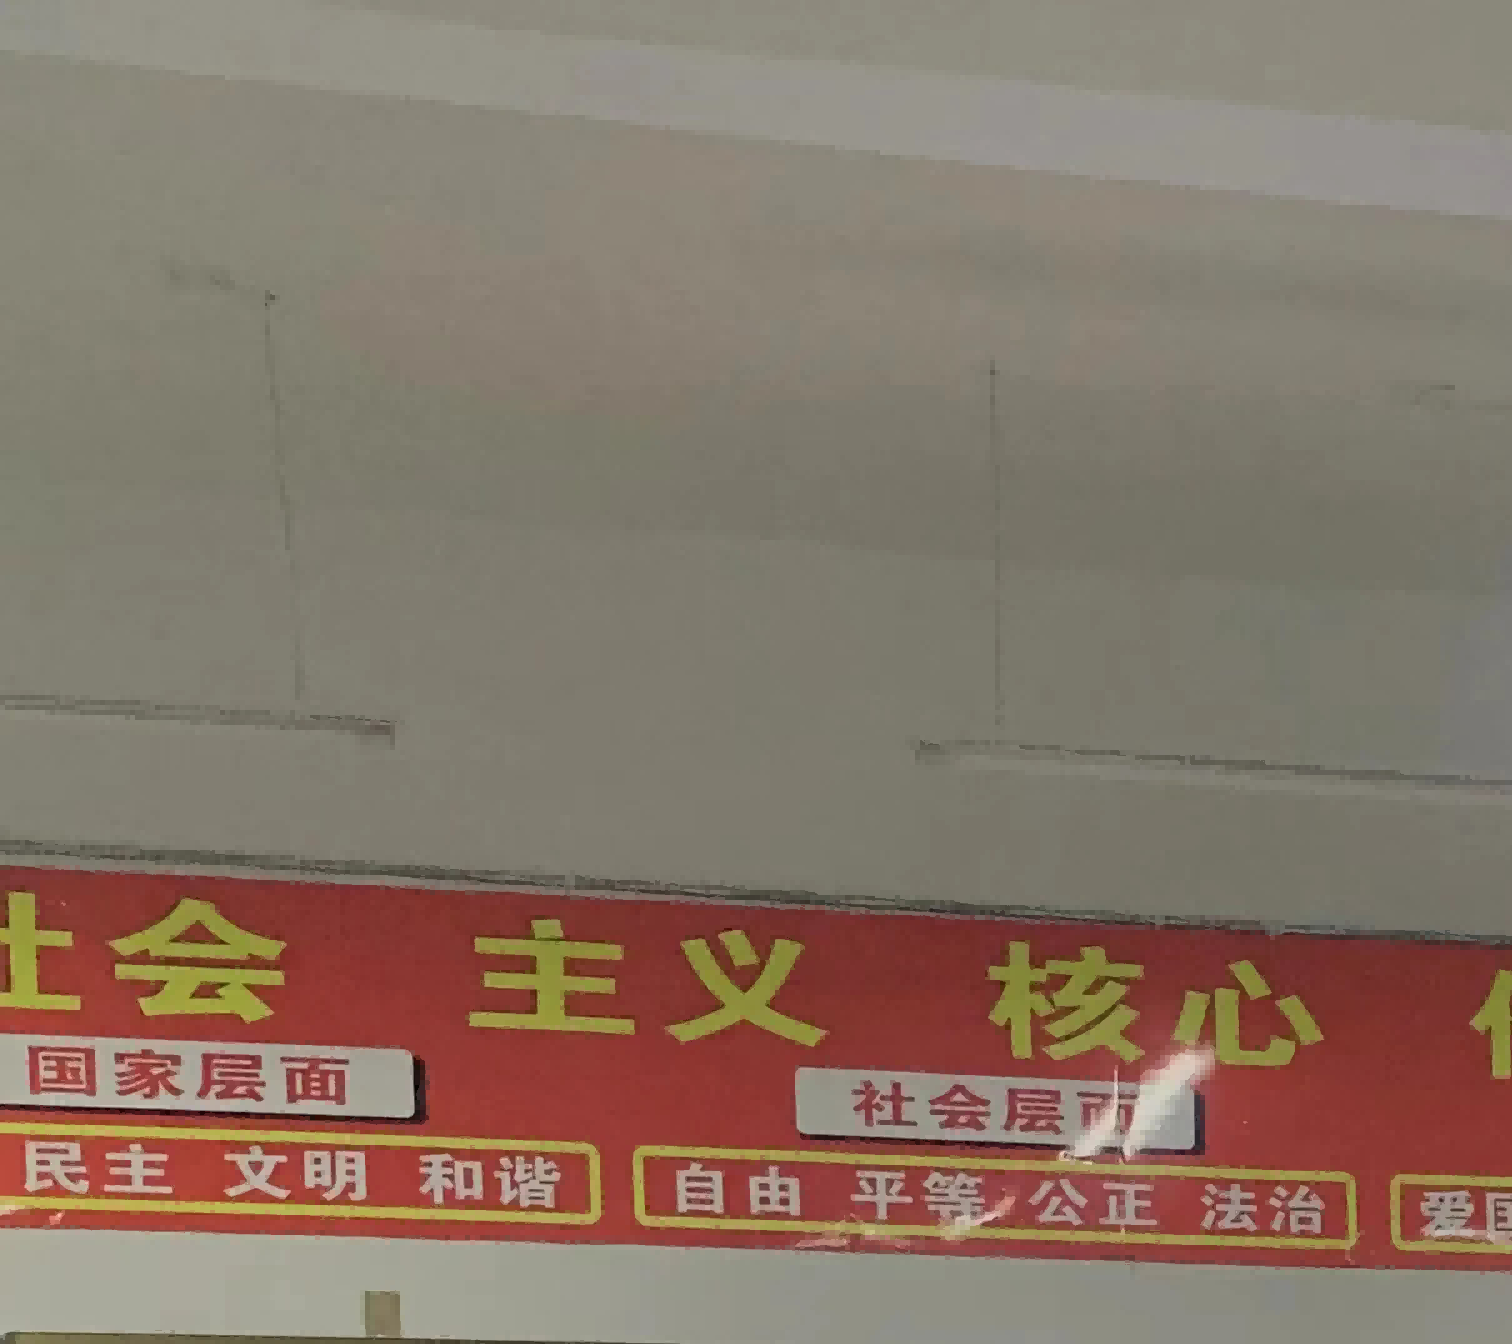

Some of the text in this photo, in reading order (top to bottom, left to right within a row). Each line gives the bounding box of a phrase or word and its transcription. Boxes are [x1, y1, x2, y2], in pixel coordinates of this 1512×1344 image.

[469, 919, 827, 1047] 主义
[988, 941, 1323, 1067] 核心
[27, 1045, 349, 1107] 国家层面
[851, 1079, 1142, 1137] 社会层面
[23, 1142, 562, 1210] 民主 文明 和谐
[676, 1163, 1326, 1234] 自由 平等 公正 法治
